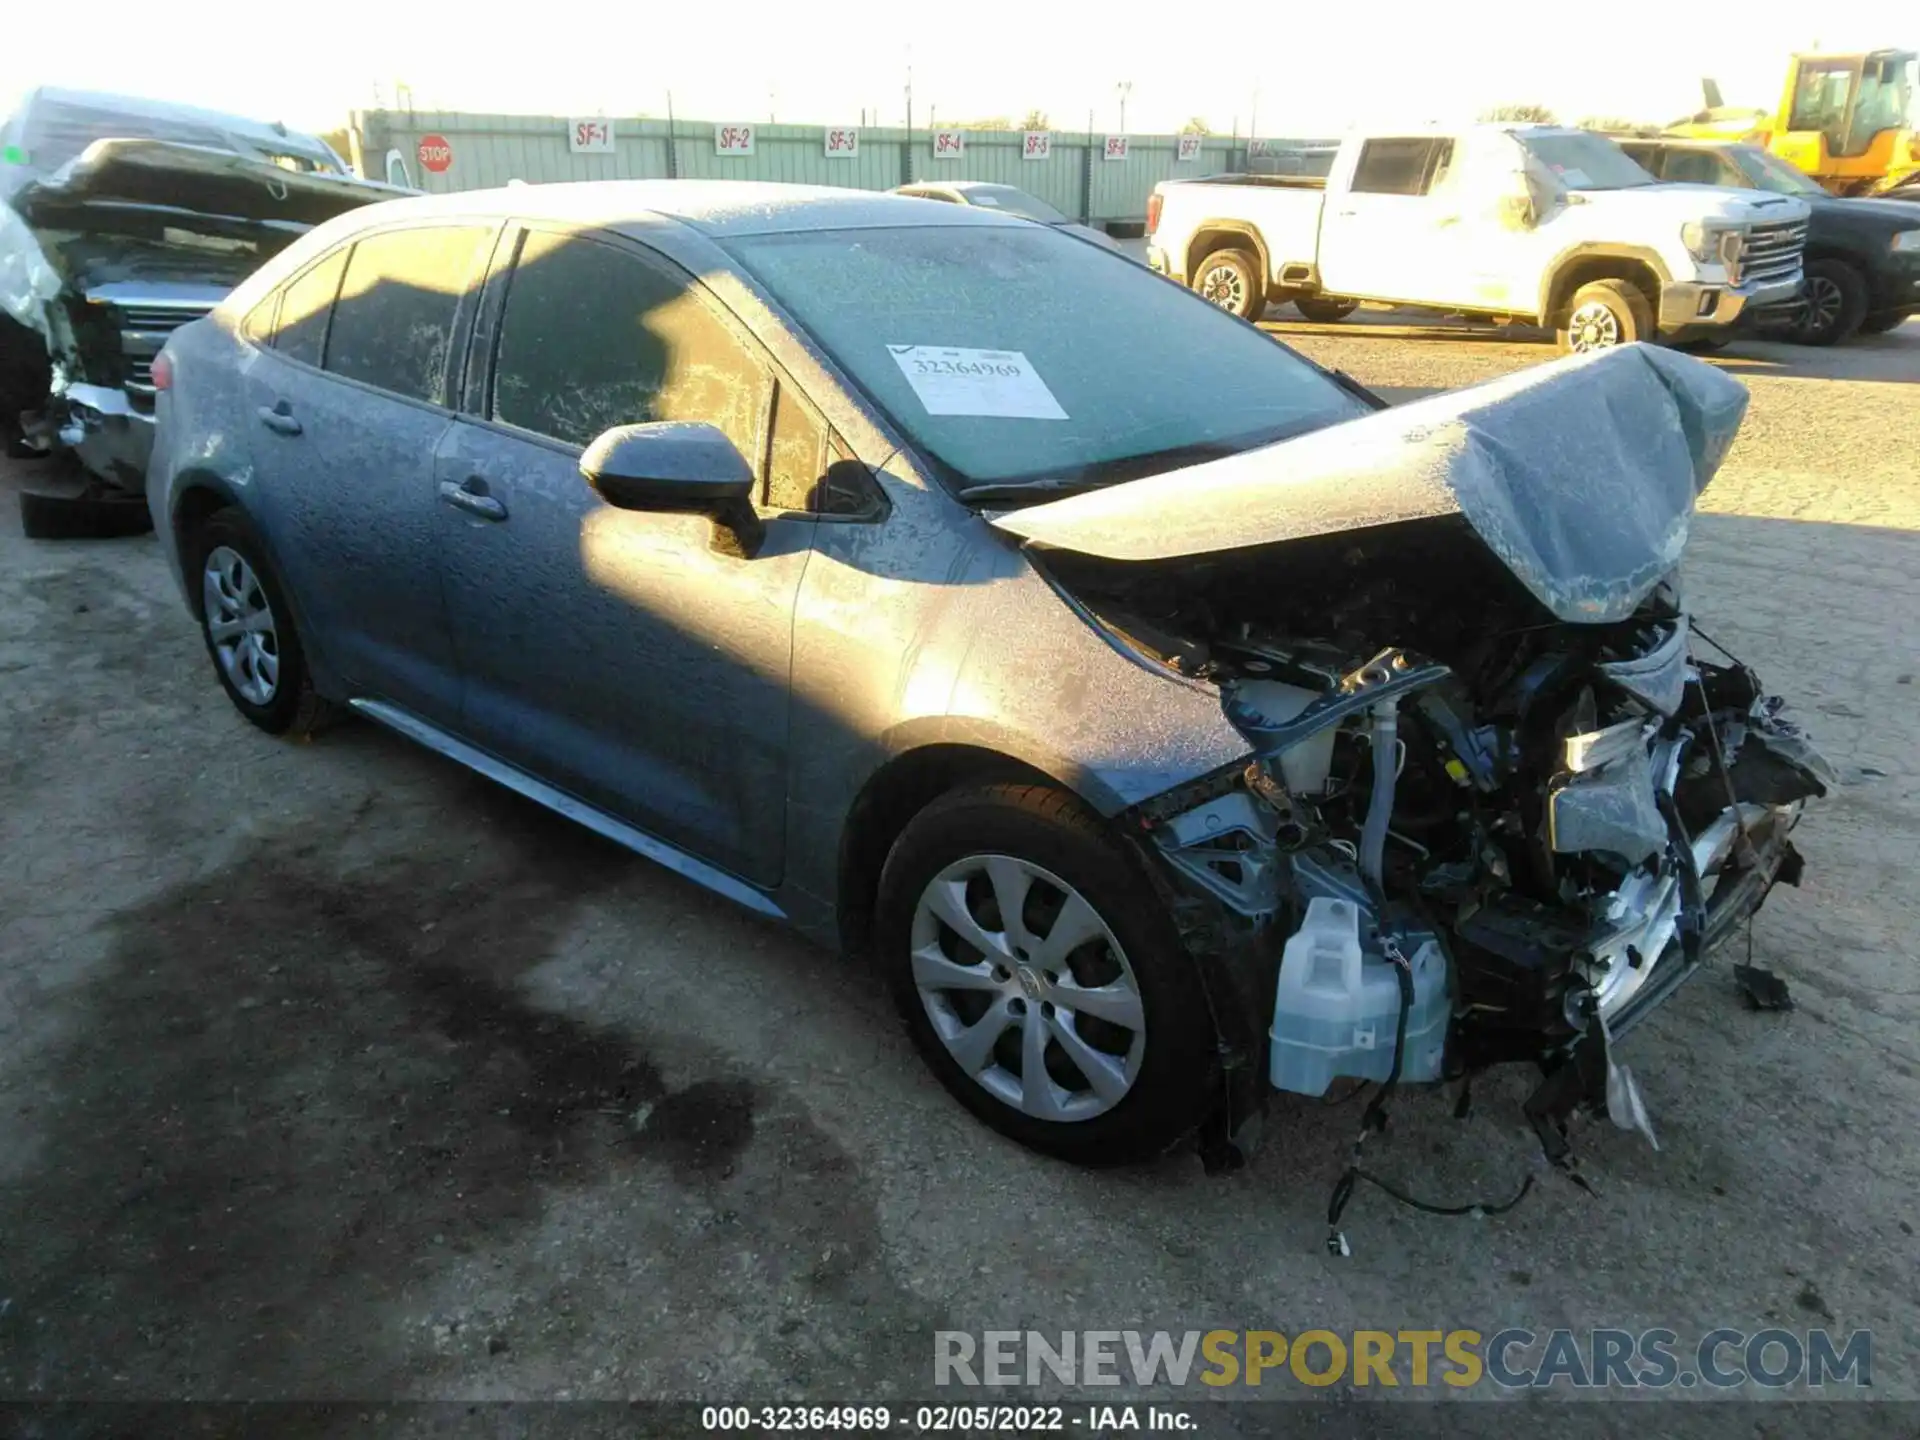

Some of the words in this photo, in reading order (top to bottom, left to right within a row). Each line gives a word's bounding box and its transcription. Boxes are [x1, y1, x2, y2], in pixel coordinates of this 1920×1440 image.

[576, 123, 608, 146] SF-1
[720, 127, 749, 149] SF-2
[829, 131, 855, 151] SF-3
[937, 133, 960, 151] SF-4
[420, 146, 449, 161] STOP
[1026, 136, 1047, 154] SF-5
[913, 360, 1020, 377] 32364969
